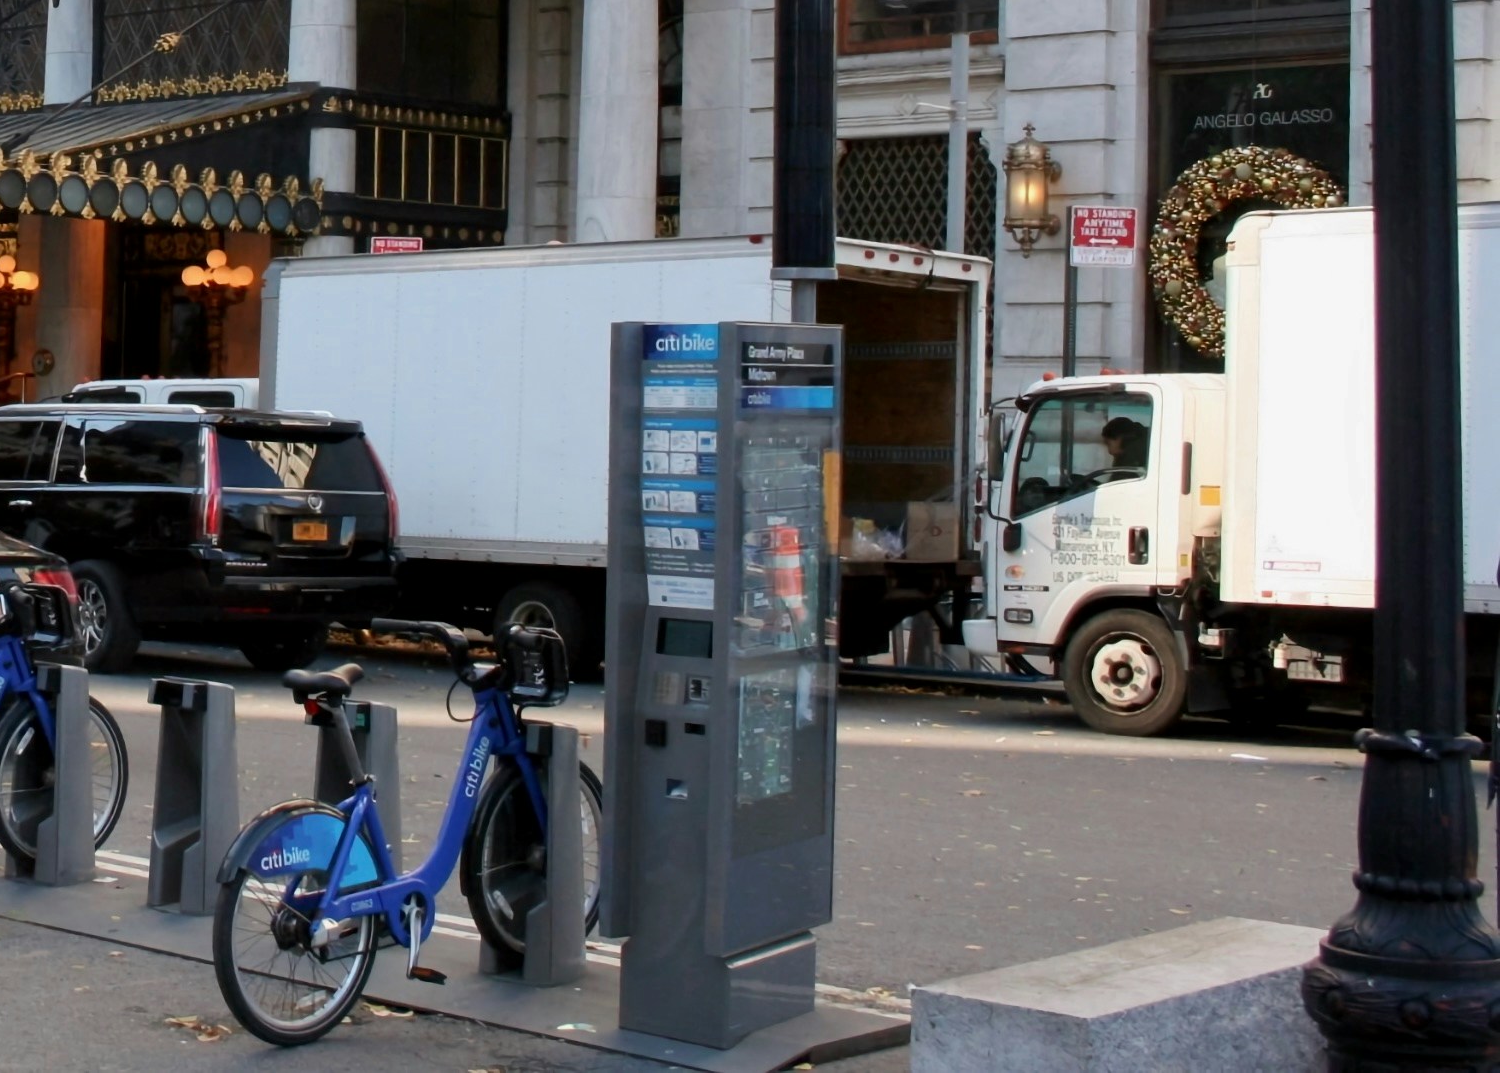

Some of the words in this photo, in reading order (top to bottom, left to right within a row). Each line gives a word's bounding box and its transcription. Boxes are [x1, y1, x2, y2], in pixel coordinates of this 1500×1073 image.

[1193, 112, 1256, 130] ANGELO
[1259, 107, 1334, 126] GALASSO
[1077, 209, 1089, 218] NO
[1092, 209, 1133, 219] STANDING
[1083, 218, 1125, 228] ANYTIME
[655, 335, 680, 352] citi
[682, 333, 715, 352] bike
[748, 345, 769, 358] Grand
[770, 346, 786, 362] Army
[787, 346, 804, 359] Plaza
[469, 735, 490, 772] bike
[465, 771, 479, 798] citi
[260, 852, 282, 871] citi
[282, 846, 311, 867] bike
